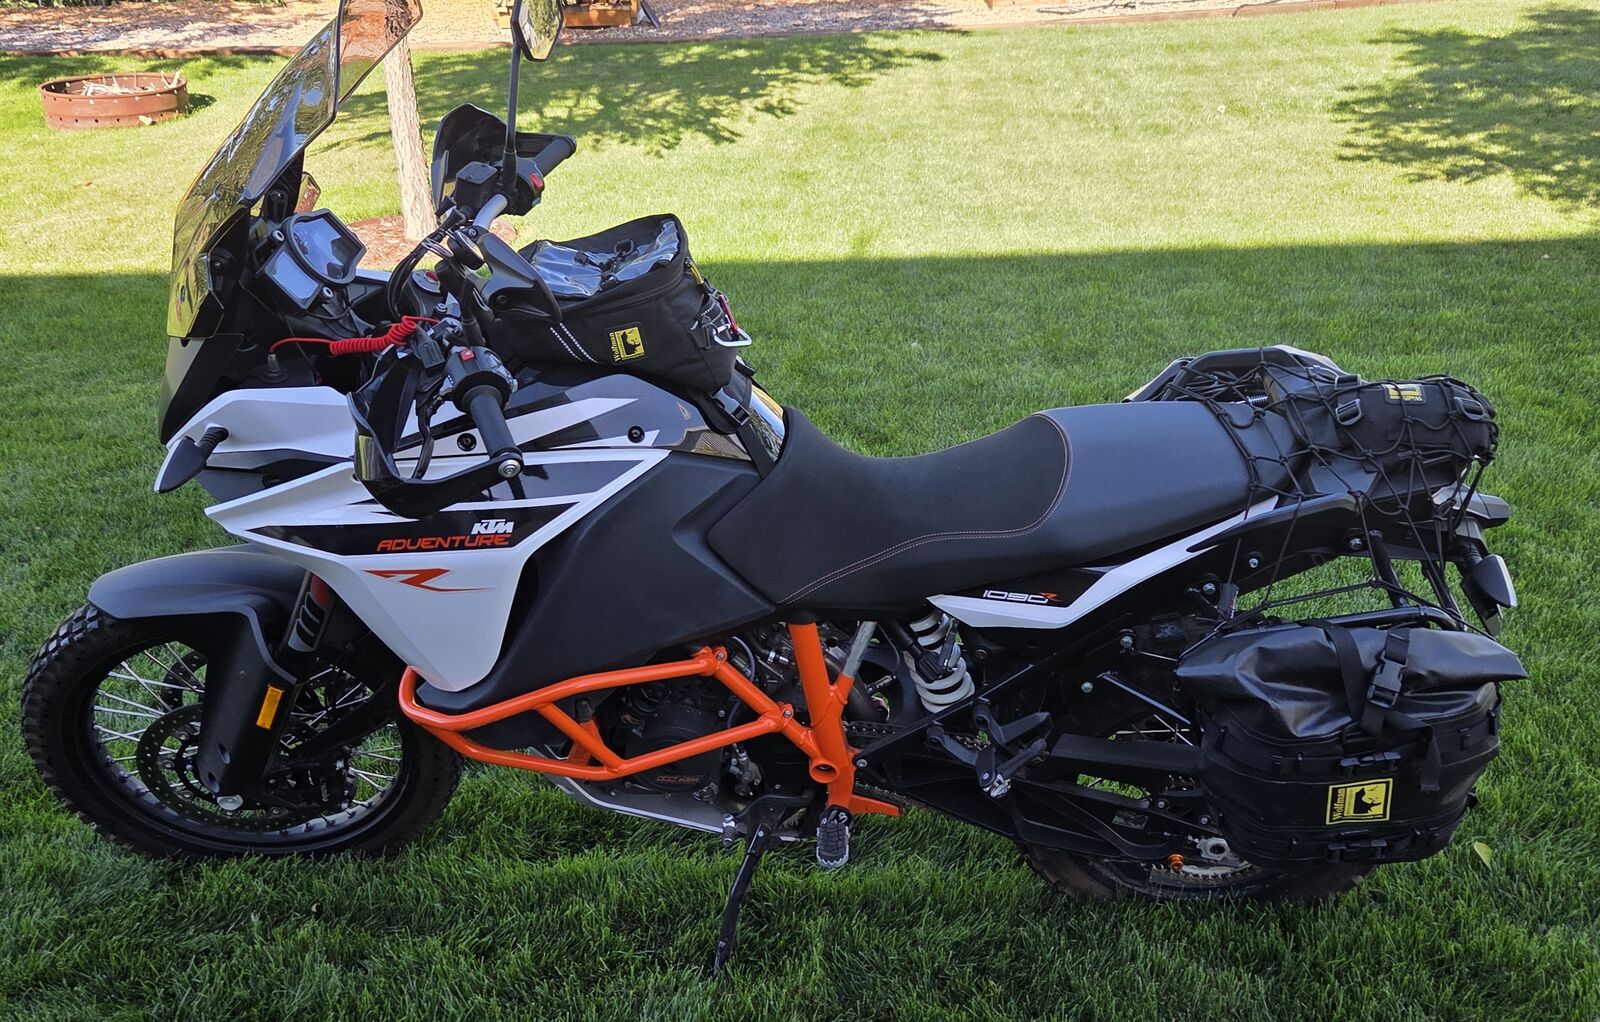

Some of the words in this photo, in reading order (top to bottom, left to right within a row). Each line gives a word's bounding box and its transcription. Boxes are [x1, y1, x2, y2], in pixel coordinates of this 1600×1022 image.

[609, 332, 621, 361] Wolfman
[471, 519, 515, 534] KTM
[377, 534, 512, 551] ADVENTURE
[1332, 788, 1346, 820] Wolfman
